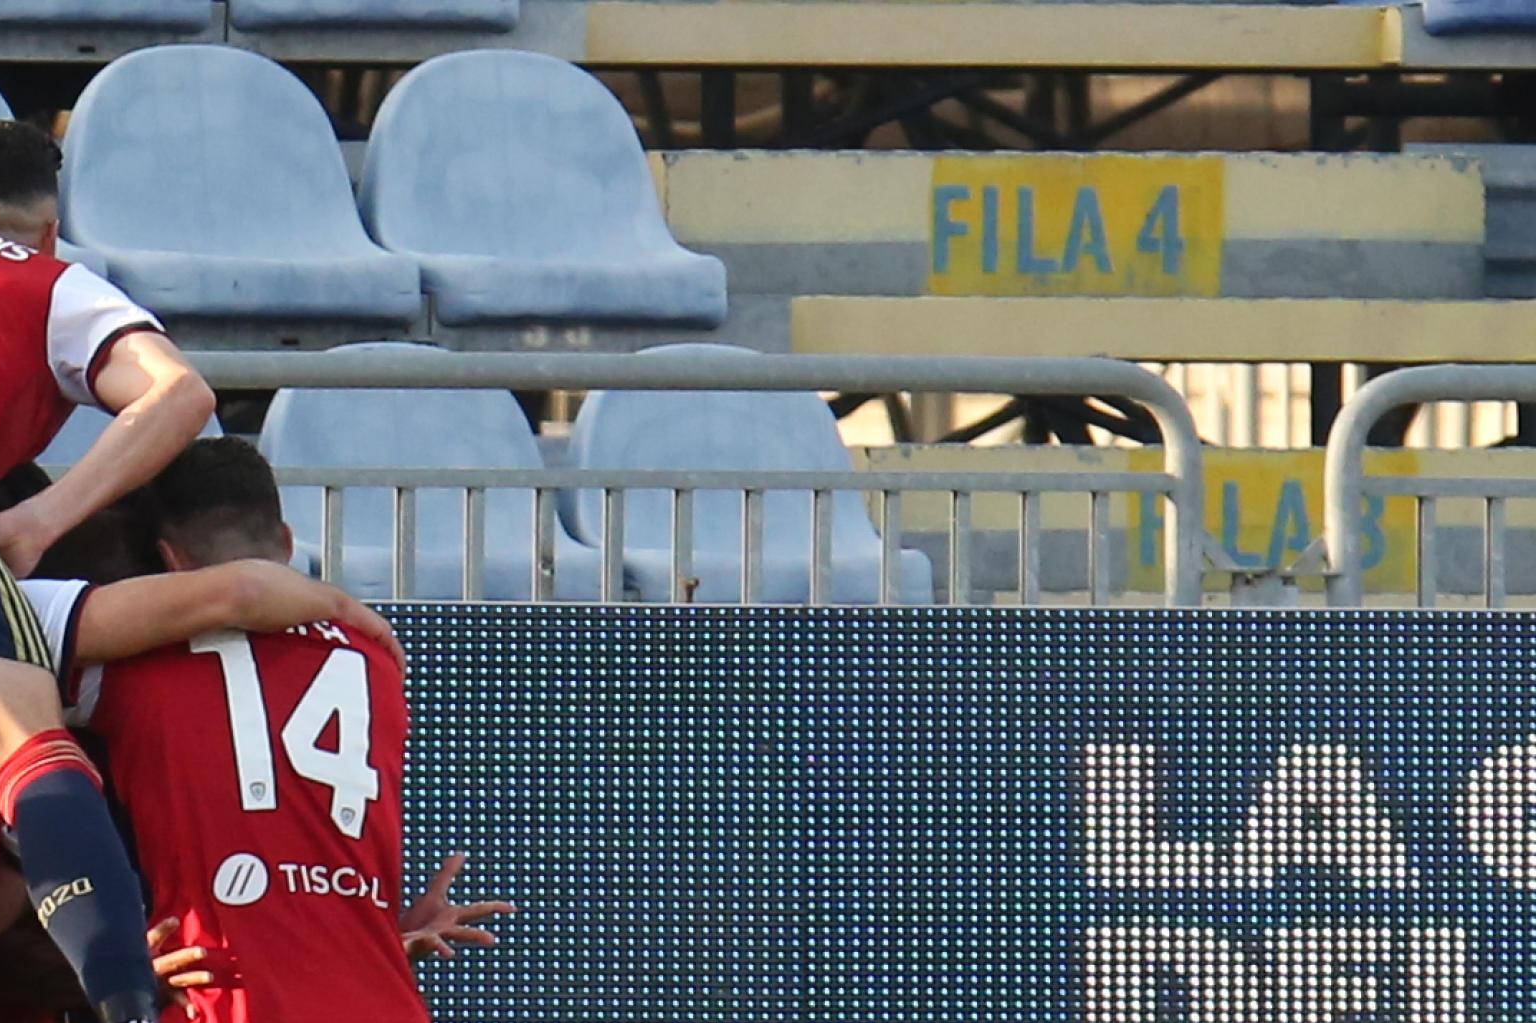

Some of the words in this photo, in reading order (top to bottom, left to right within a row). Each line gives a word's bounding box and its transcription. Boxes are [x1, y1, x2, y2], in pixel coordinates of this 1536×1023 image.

[932, 184, 1114, 274] FILA
[1136, 184, 1185, 274] 4
[1139, 479, 1312, 569] FLA
[189, 630, 380, 840] 14
[1083, 742, 1422, 891] LA
